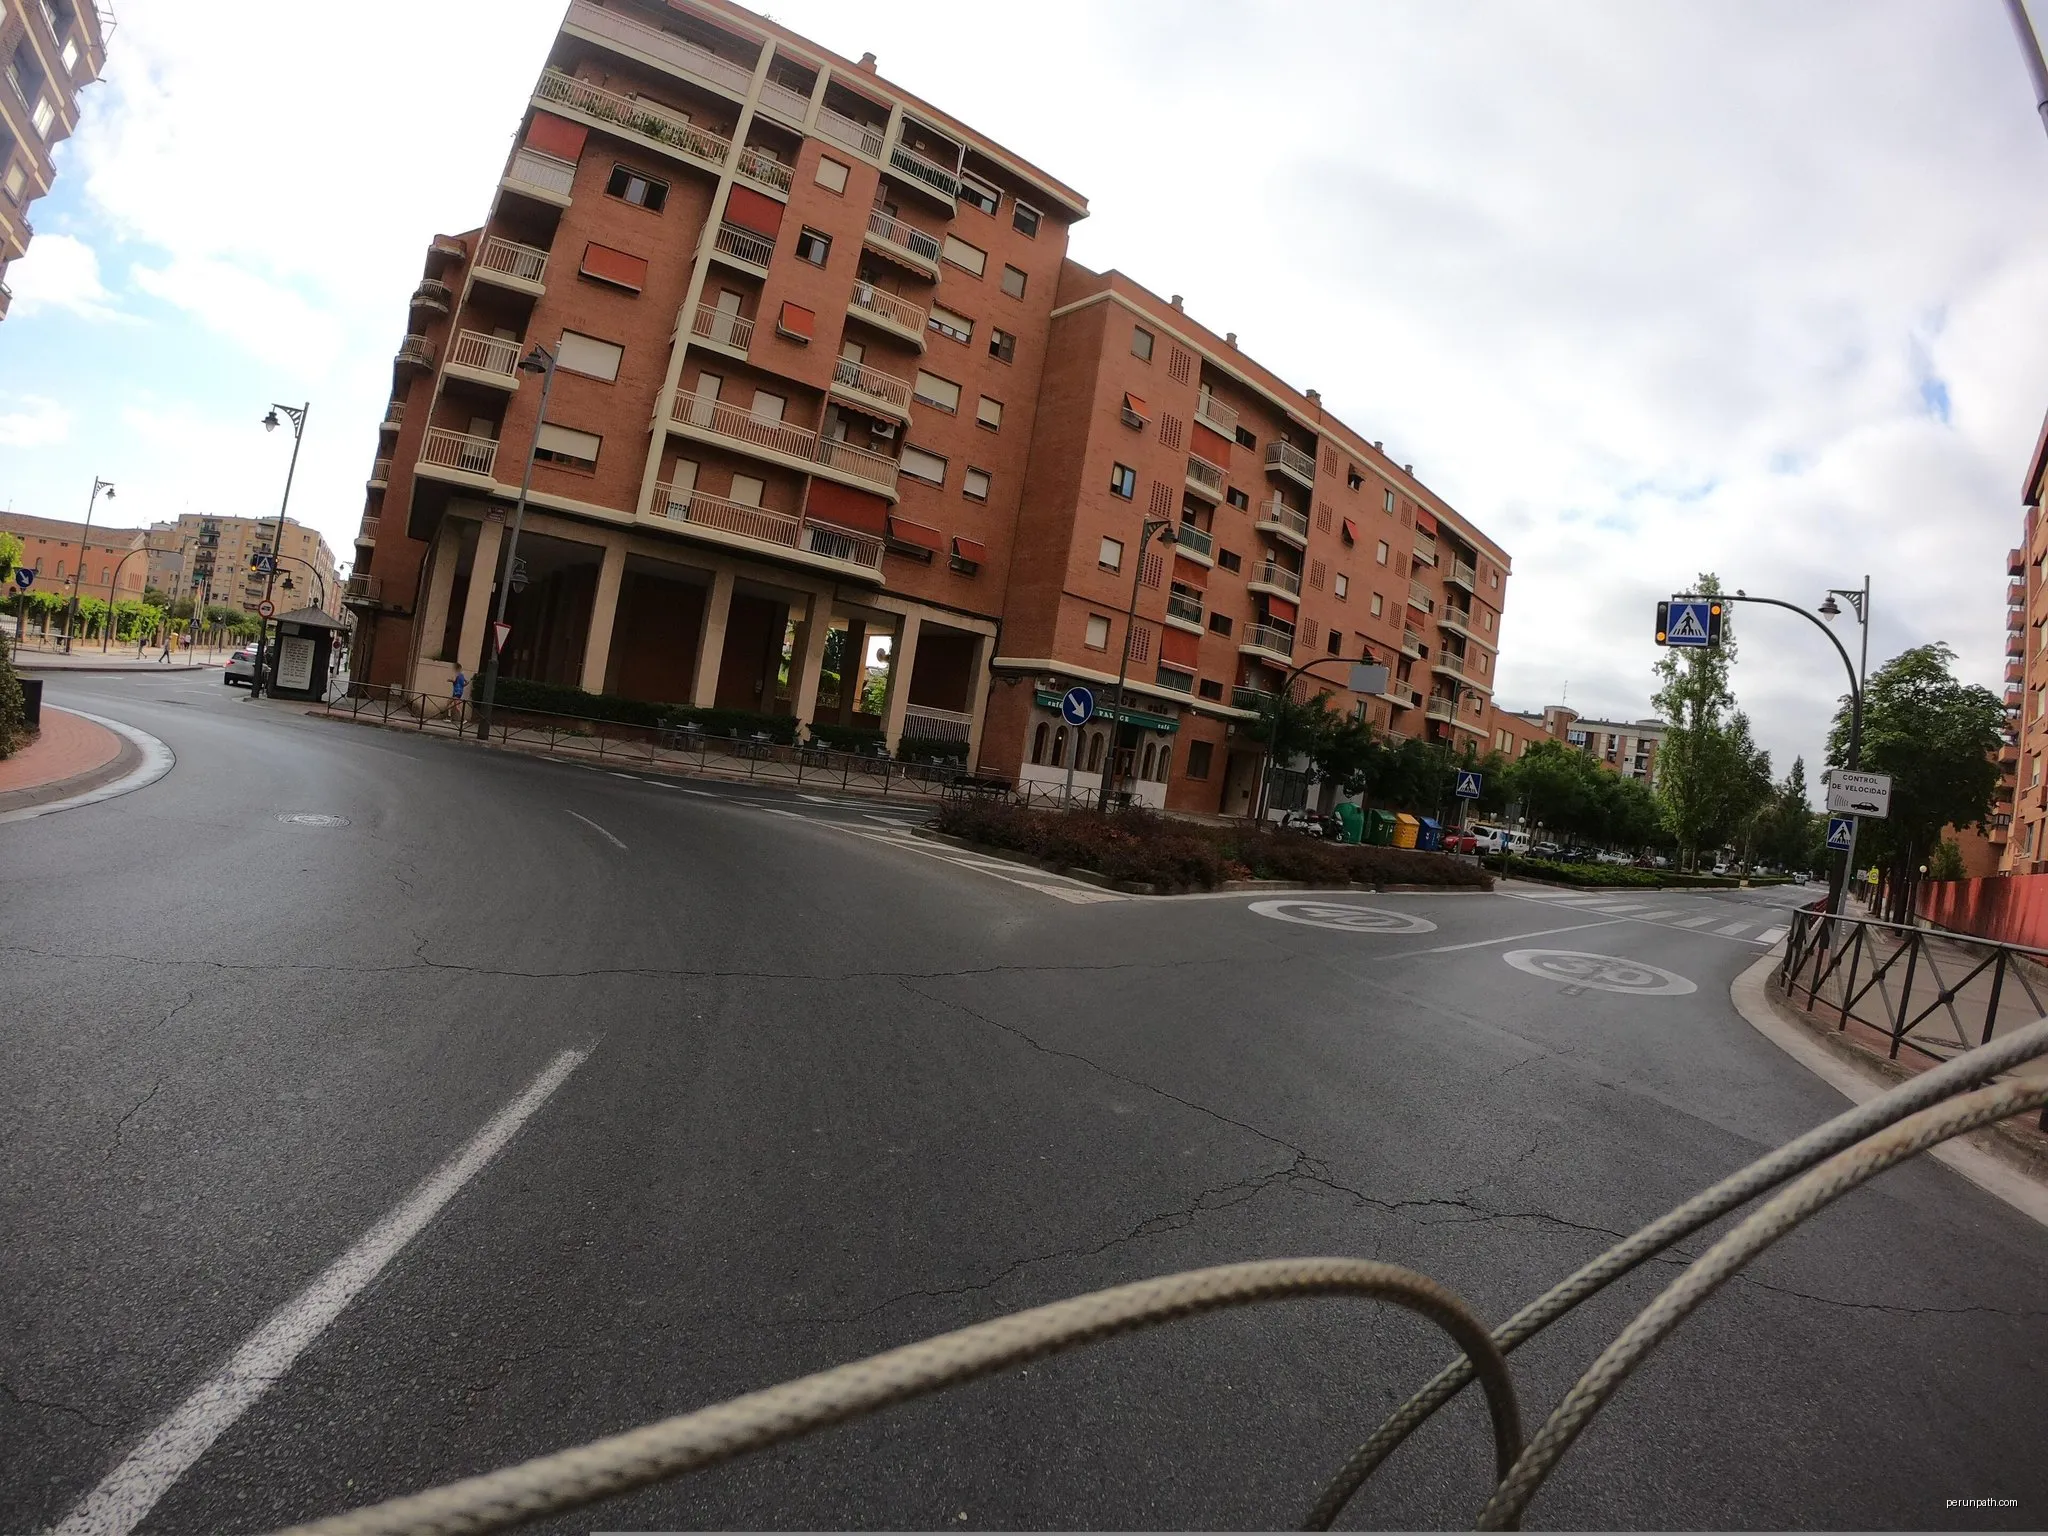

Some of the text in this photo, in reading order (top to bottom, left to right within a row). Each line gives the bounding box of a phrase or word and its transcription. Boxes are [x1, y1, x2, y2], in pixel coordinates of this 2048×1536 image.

[1098, 710, 1130, 723] PALCE
[1842, 774, 1878, 784] CONTROL
[1845, 785, 1887, 796] VELOCIDAD
